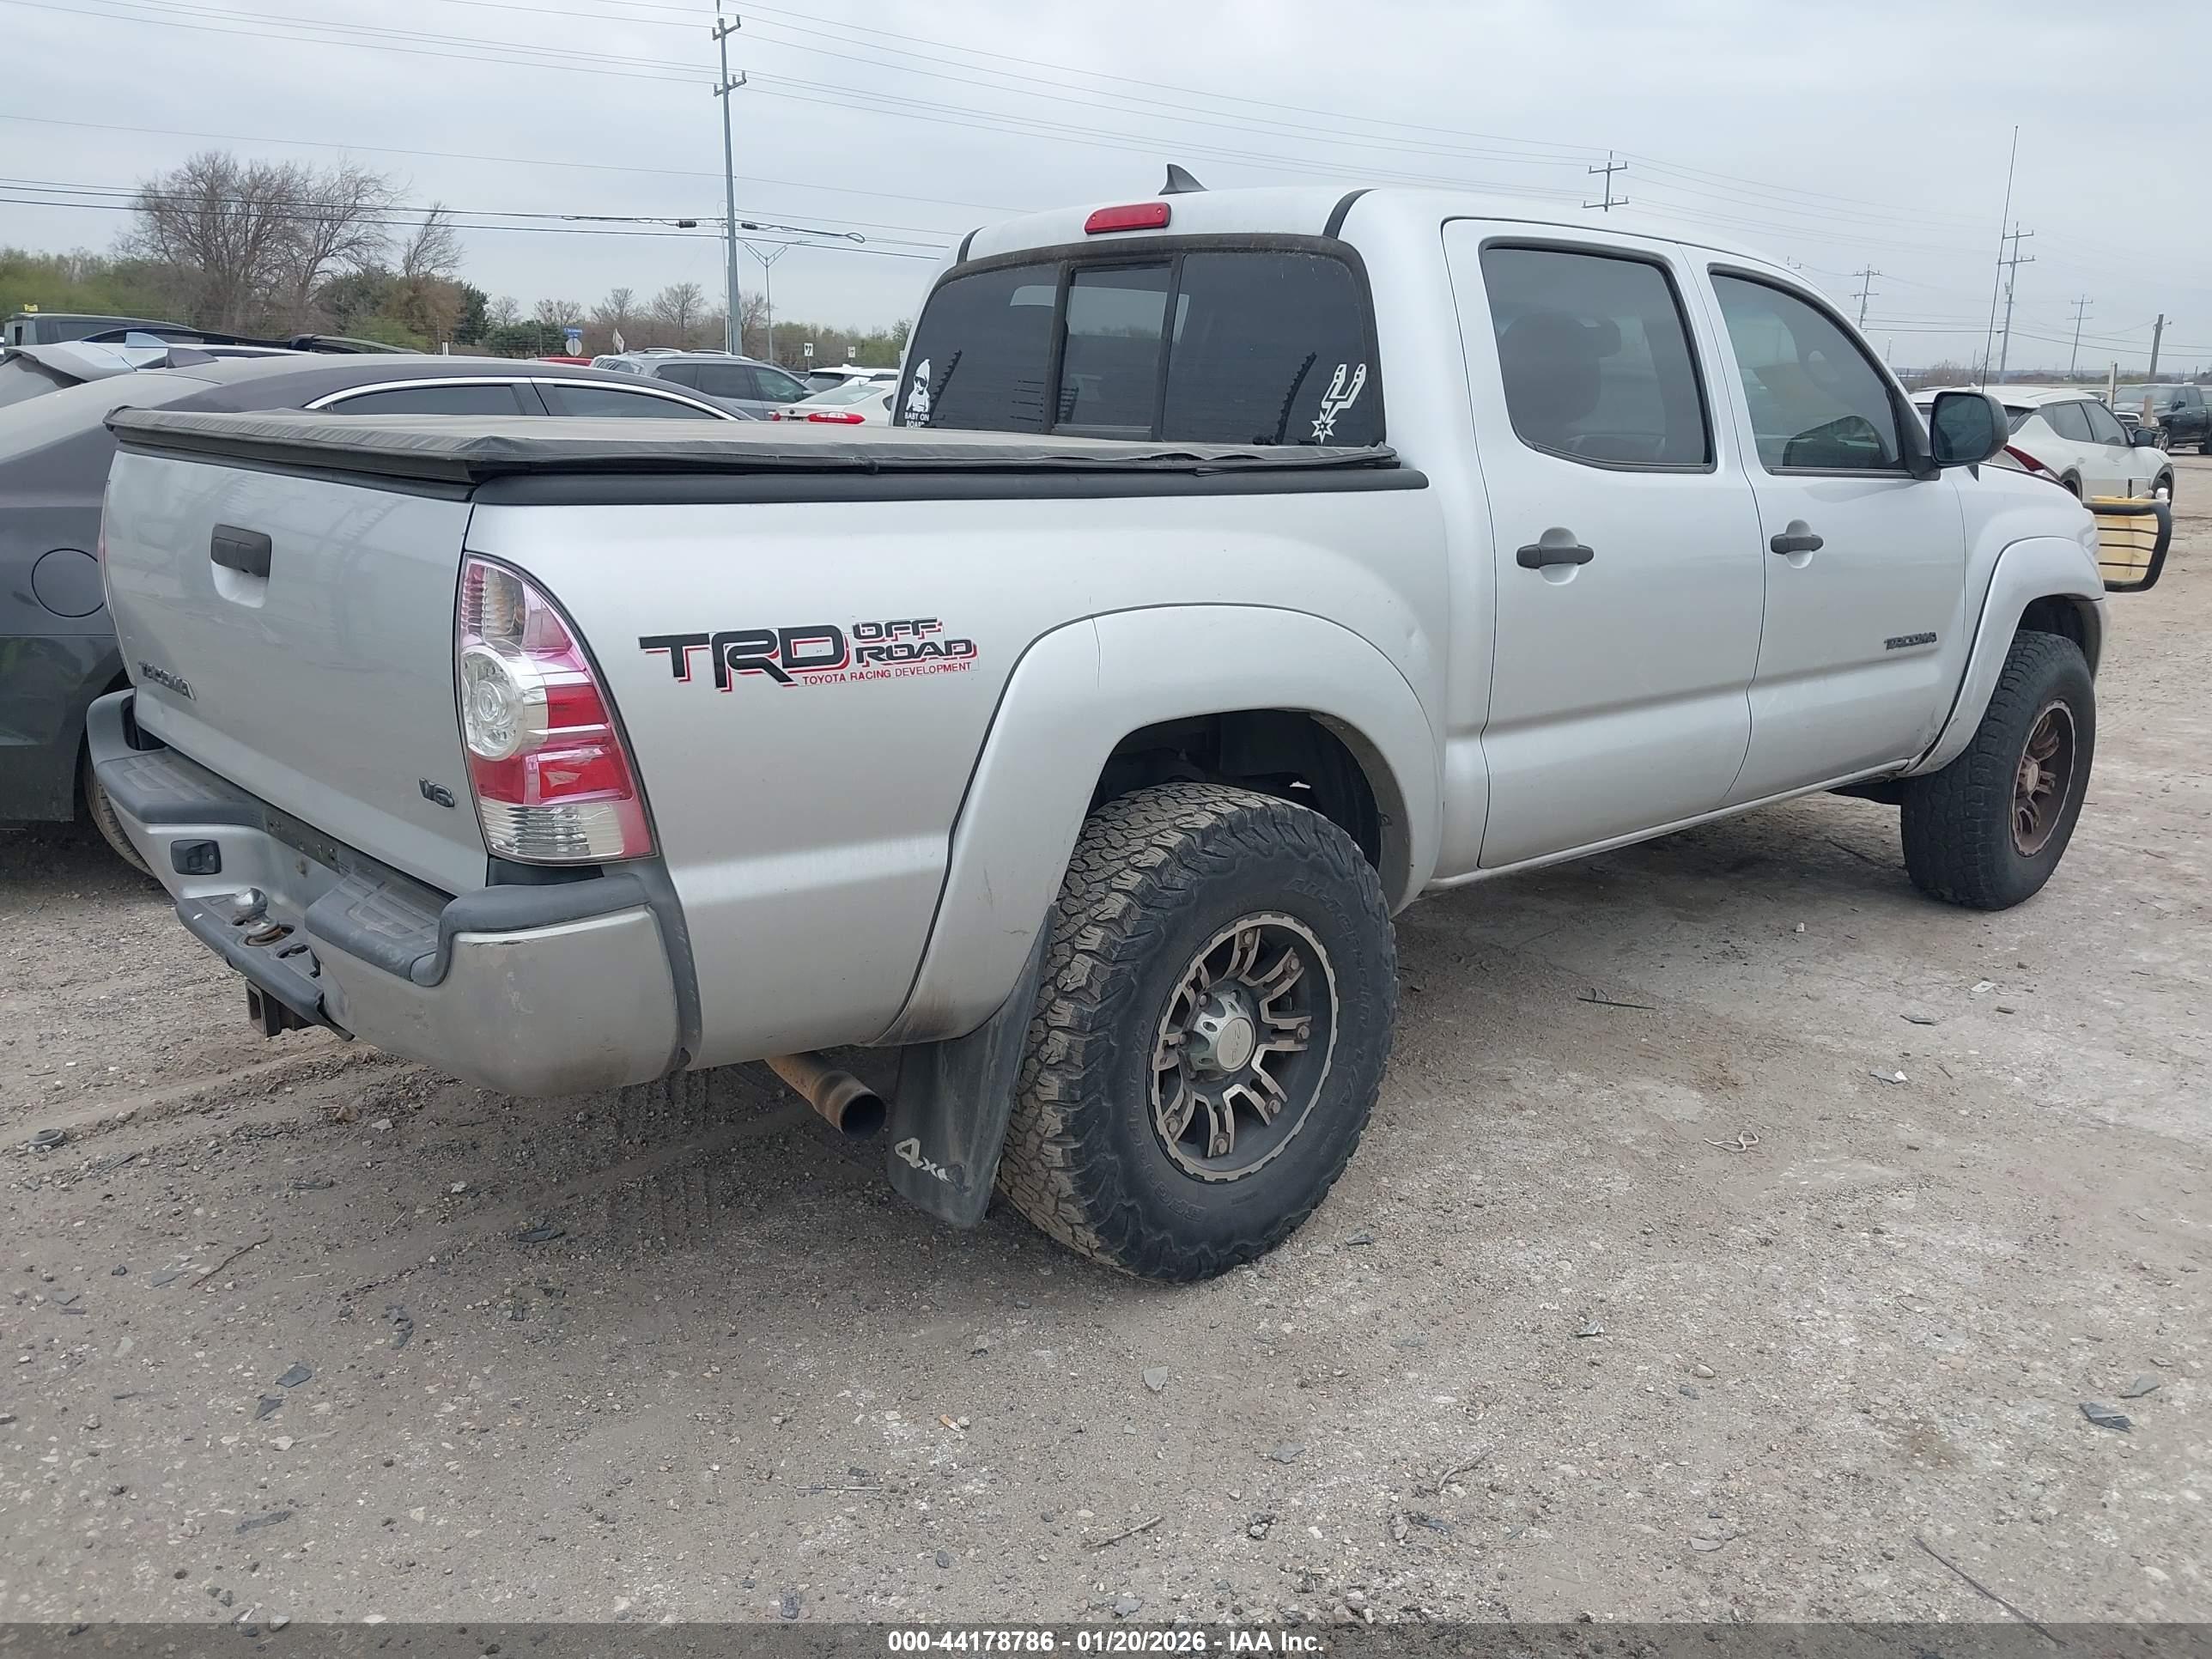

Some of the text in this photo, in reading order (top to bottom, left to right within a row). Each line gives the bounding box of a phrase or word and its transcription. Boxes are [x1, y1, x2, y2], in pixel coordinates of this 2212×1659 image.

[920, 413, 930, 422] ON
[852, 617, 943, 643] OFF
[638, 623, 851, 692] TRD
[855, 639, 978, 668] ROAD
[802, 661, 972, 686] TOYOTA RACING DEVELOPMENT
[418, 777, 455, 808] V6
